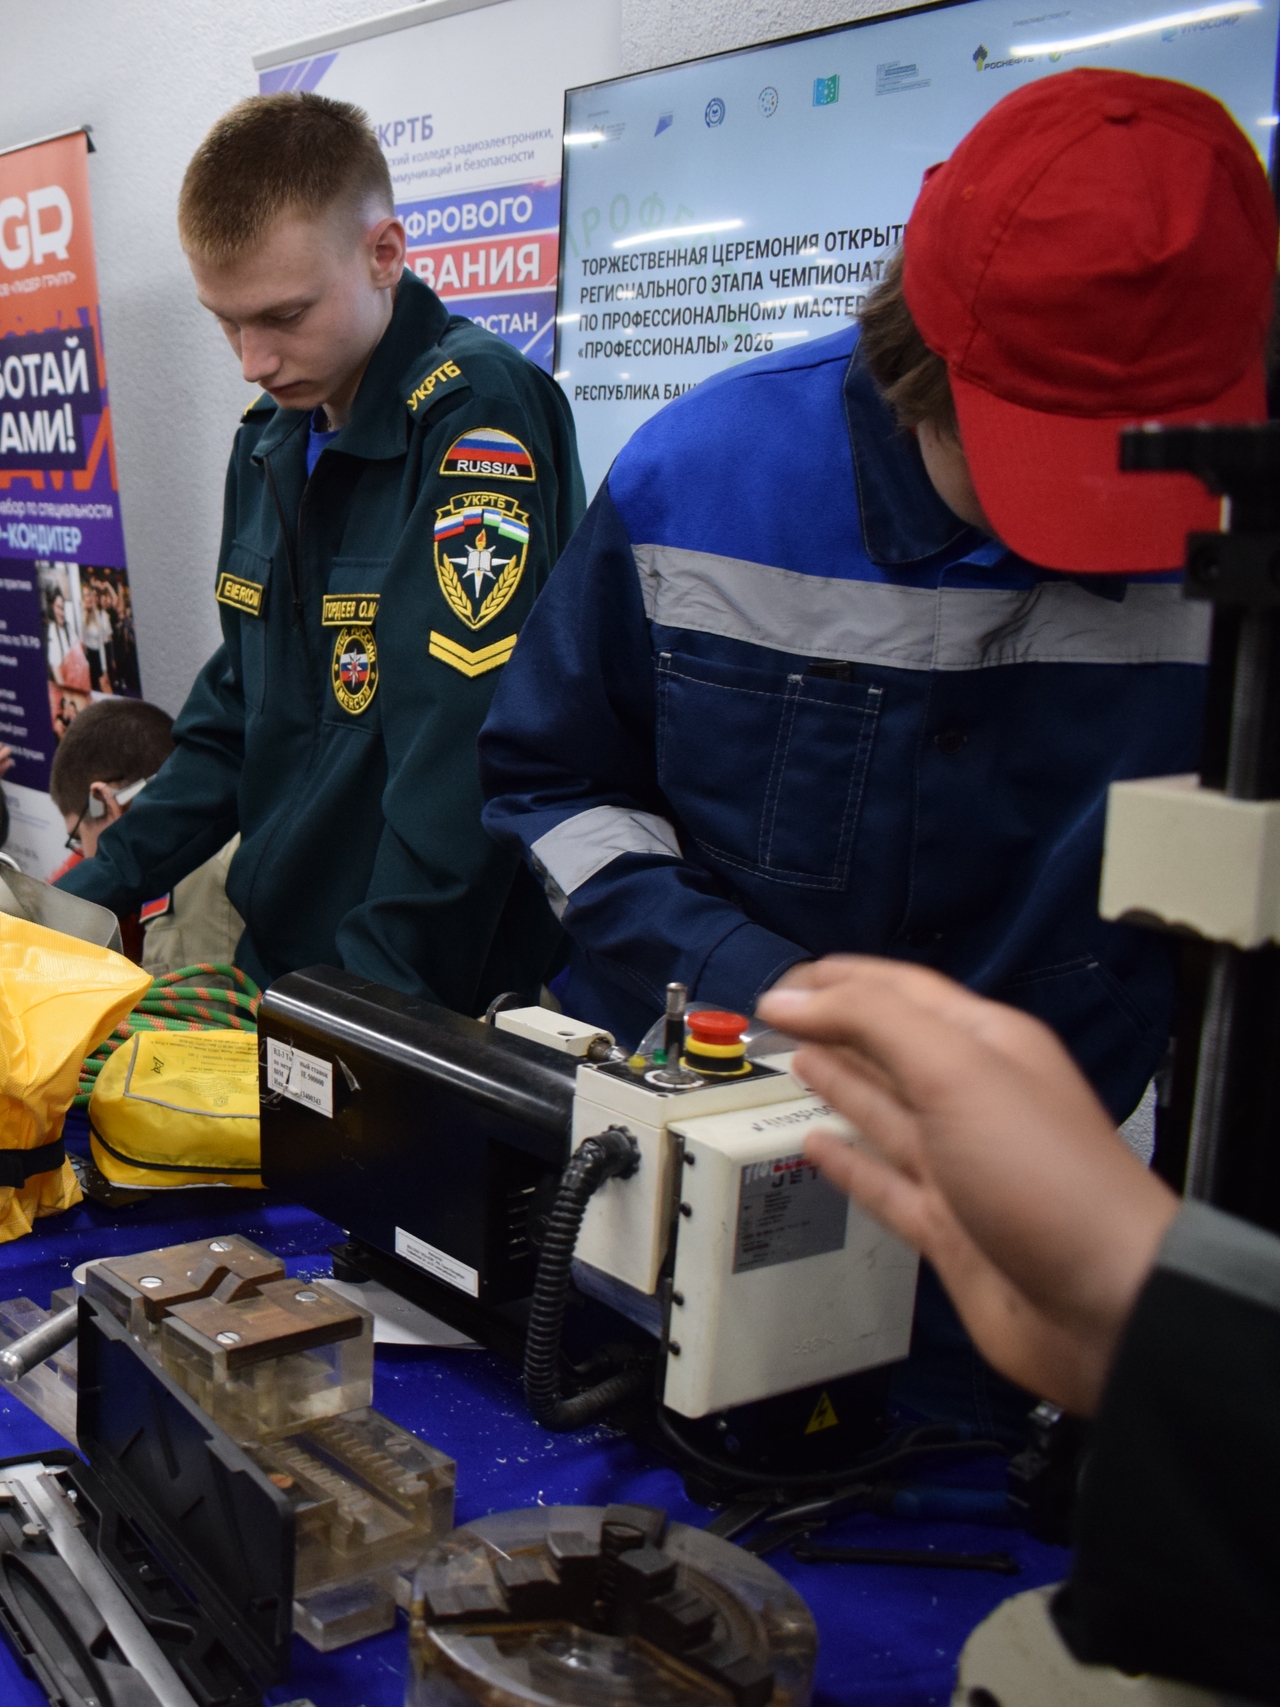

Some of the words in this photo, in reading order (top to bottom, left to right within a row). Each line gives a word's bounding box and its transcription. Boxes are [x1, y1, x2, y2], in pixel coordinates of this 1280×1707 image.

[372, 114, 434, 150] КРТБ
[411, 146, 452, 164] колледж
[453, 127, 554, 158] радиоэлектроники,
[463, 149, 535, 172] безопасности
[581, 245, 708, 277] ТОРЖЕСТВЕННАЯ
[712, 233, 820, 267] ЦЕРЕМОНИЯ
[824, 223, 908, 253] ОТКРЫТ
[404, 242, 541, 293] ВАНИЯ
[580, 275, 708, 305] РЕГИОНАЛЬНОГО
[711, 270, 764, 294] ЭТАПА
[470, 311, 538, 335] ОСТАН
[578, 314, 598, 332] ПО
[602, 299, 789, 331] ПРОФЕССИОНАЛЬНОМУ
[577, 334, 729, 359] «ПРОФЕССИОНАЛЫ»
[734, 332, 774, 353] 2026
[406, 359, 462, 411] УКРТБ
[574, 384, 661, 402] РЕСПУБЛИКА
[456, 459, 519, 477] RUSSIA
[462, 494, 507, 509] УКРТБ
[334, 680, 372, 710] EMERCOM
